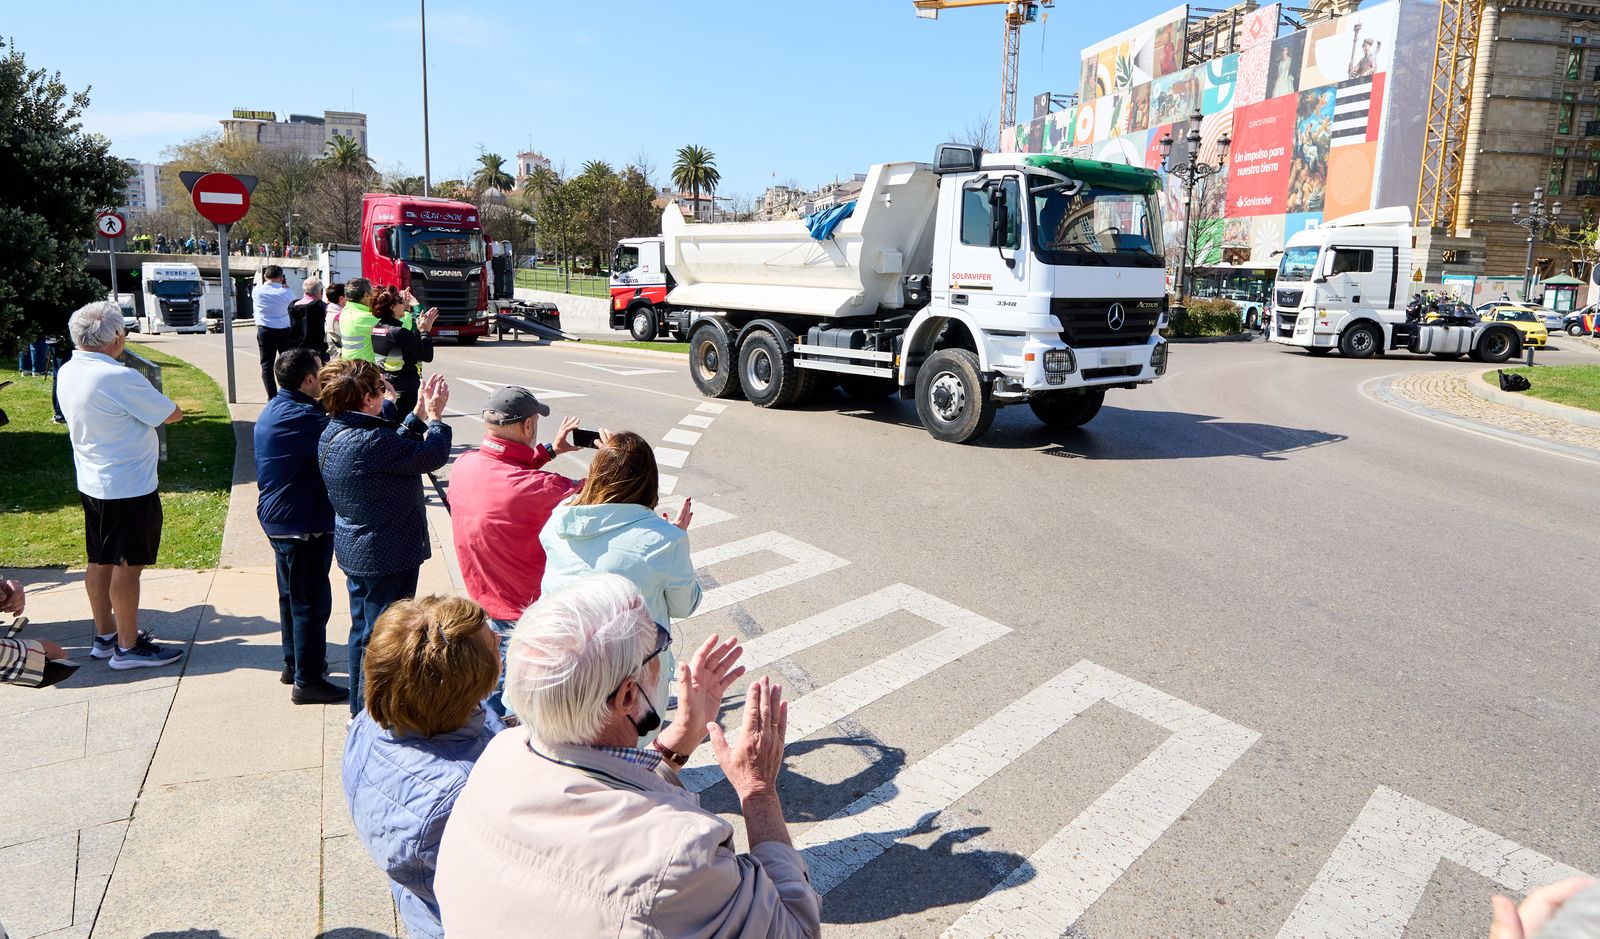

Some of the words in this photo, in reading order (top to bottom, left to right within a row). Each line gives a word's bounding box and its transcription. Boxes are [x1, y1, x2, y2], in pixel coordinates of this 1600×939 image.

[233, 111, 253, 119] HOTEL
[1235, 152, 1244, 163] Un
[1244, 148, 1269, 163] impulso
[1269, 147, 1285, 160] para
[1237, 164, 1260, 177] nuestra
[1260, 161, 1279, 175] tierra
[1243, 195, 1273, 207] Santander
[951, 272, 992, 280] SOLPAVIFER
